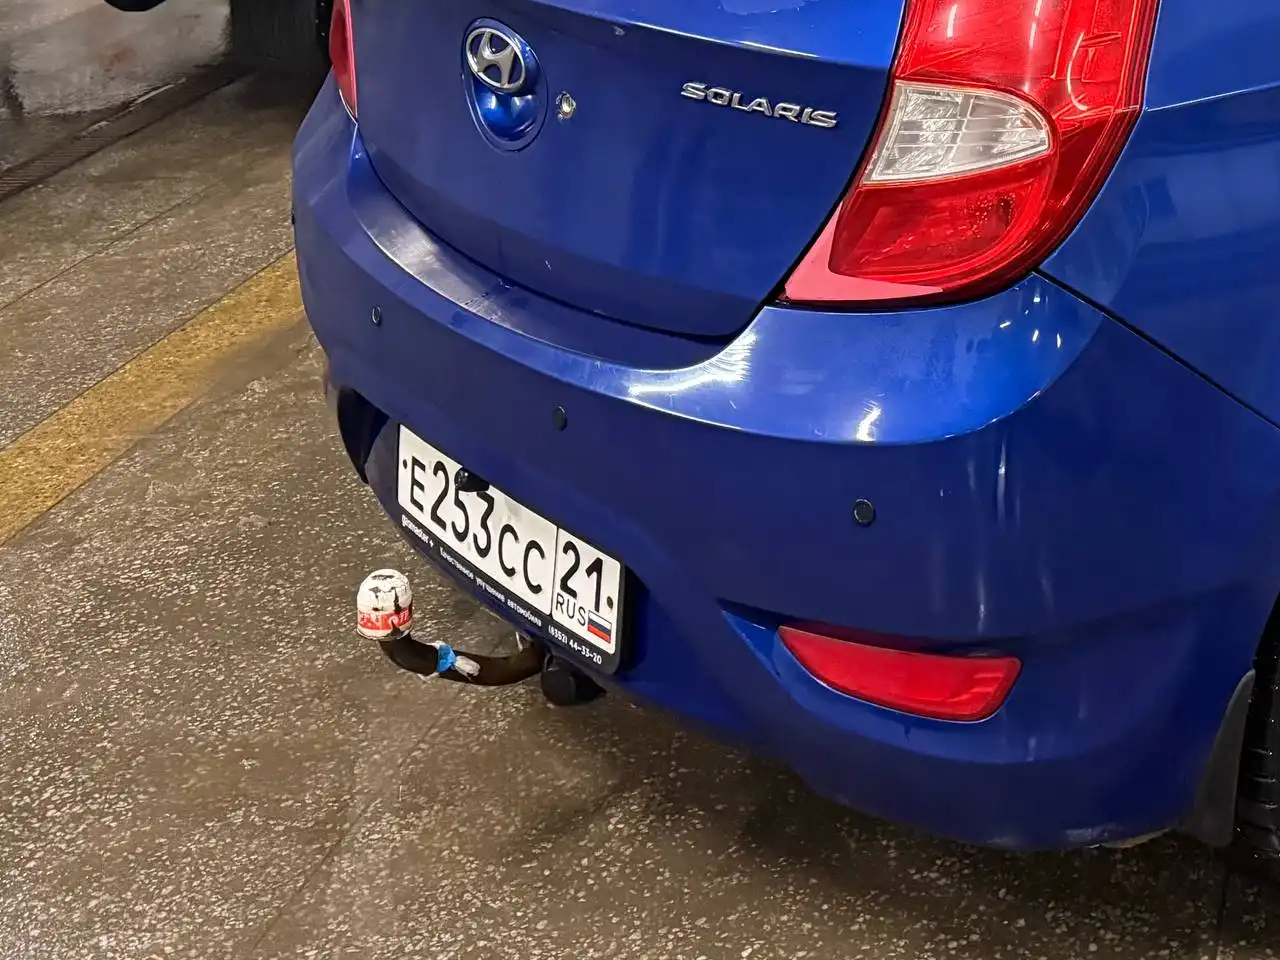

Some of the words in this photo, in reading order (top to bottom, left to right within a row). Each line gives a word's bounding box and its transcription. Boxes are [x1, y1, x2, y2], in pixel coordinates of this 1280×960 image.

[681, 81, 838, 128] SOLARIS
[560, 540, 603, 613] 21
[556, 593, 586, 627] RUS
[569, 639, 602, 664] 44-33-20
